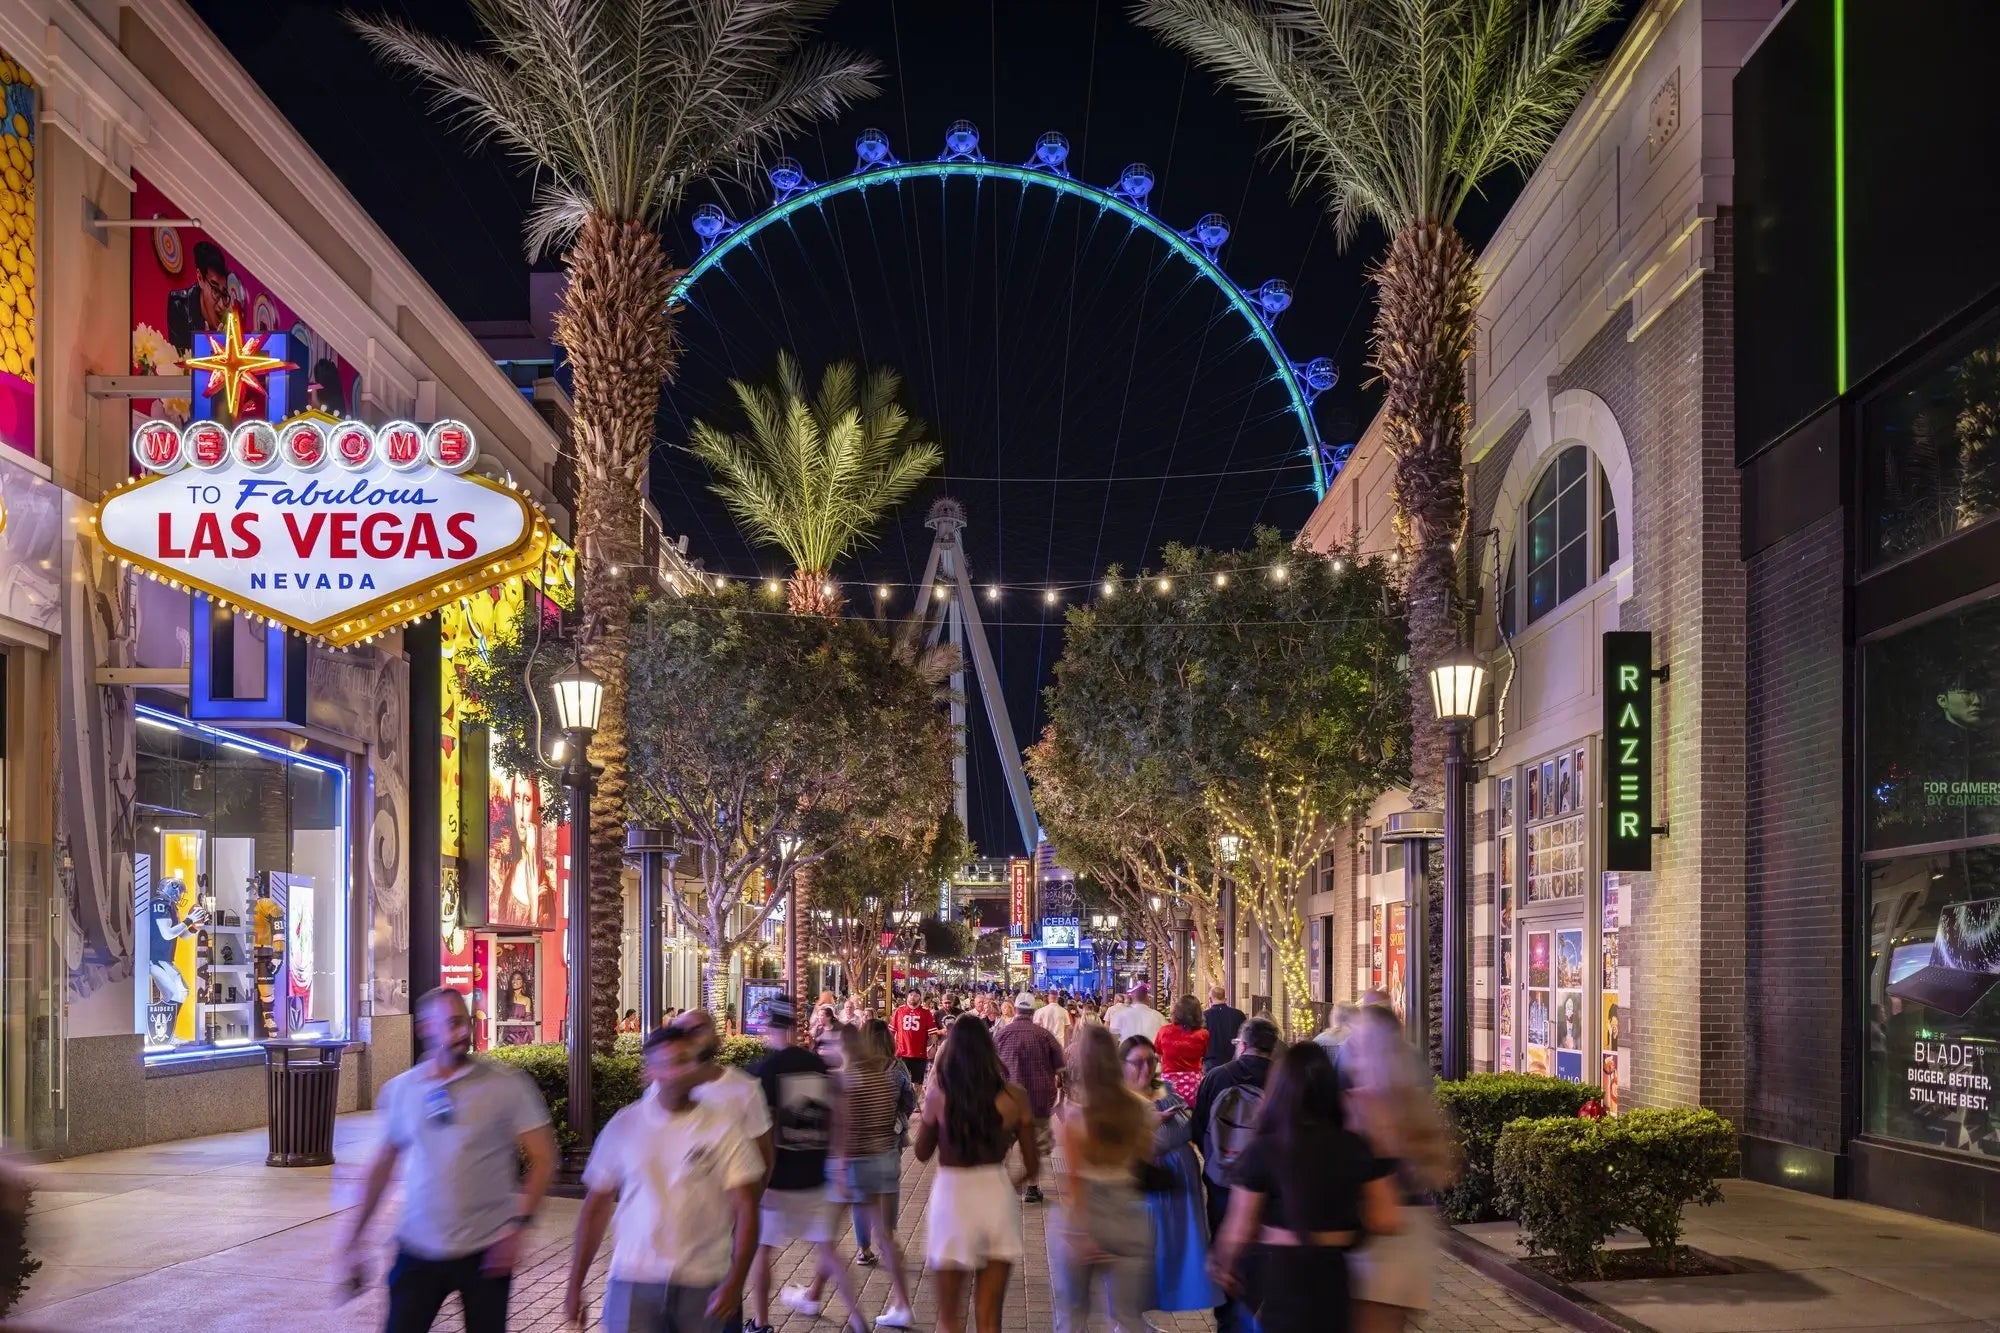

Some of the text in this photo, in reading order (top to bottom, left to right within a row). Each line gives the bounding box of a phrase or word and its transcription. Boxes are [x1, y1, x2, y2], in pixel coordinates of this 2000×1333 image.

[142, 429, 465, 463] WELCOME
[187, 478, 438, 511] TO Fabulous
[157, 511, 478, 560] LAS VEGAS
[250, 572, 377, 590] NEVADA
[1923, 781, 1948, 794] FOR
[1927, 794, 2000, 807] BY GAMERS
[153, 903, 165, 913] 10
[273, 920, 285, 930] 81
[1042, 917, 1079, 926] ICEBAR
[902, 1014, 921, 1032] 85
[1914, 1041, 1974, 1067] BLADE
[1975, 1046, 1985, 1056] 16
[1907, 1068, 1992, 1091] BIGGER. BETTER.
[1909, 1087, 1989, 1111] STILL THE BEST.
